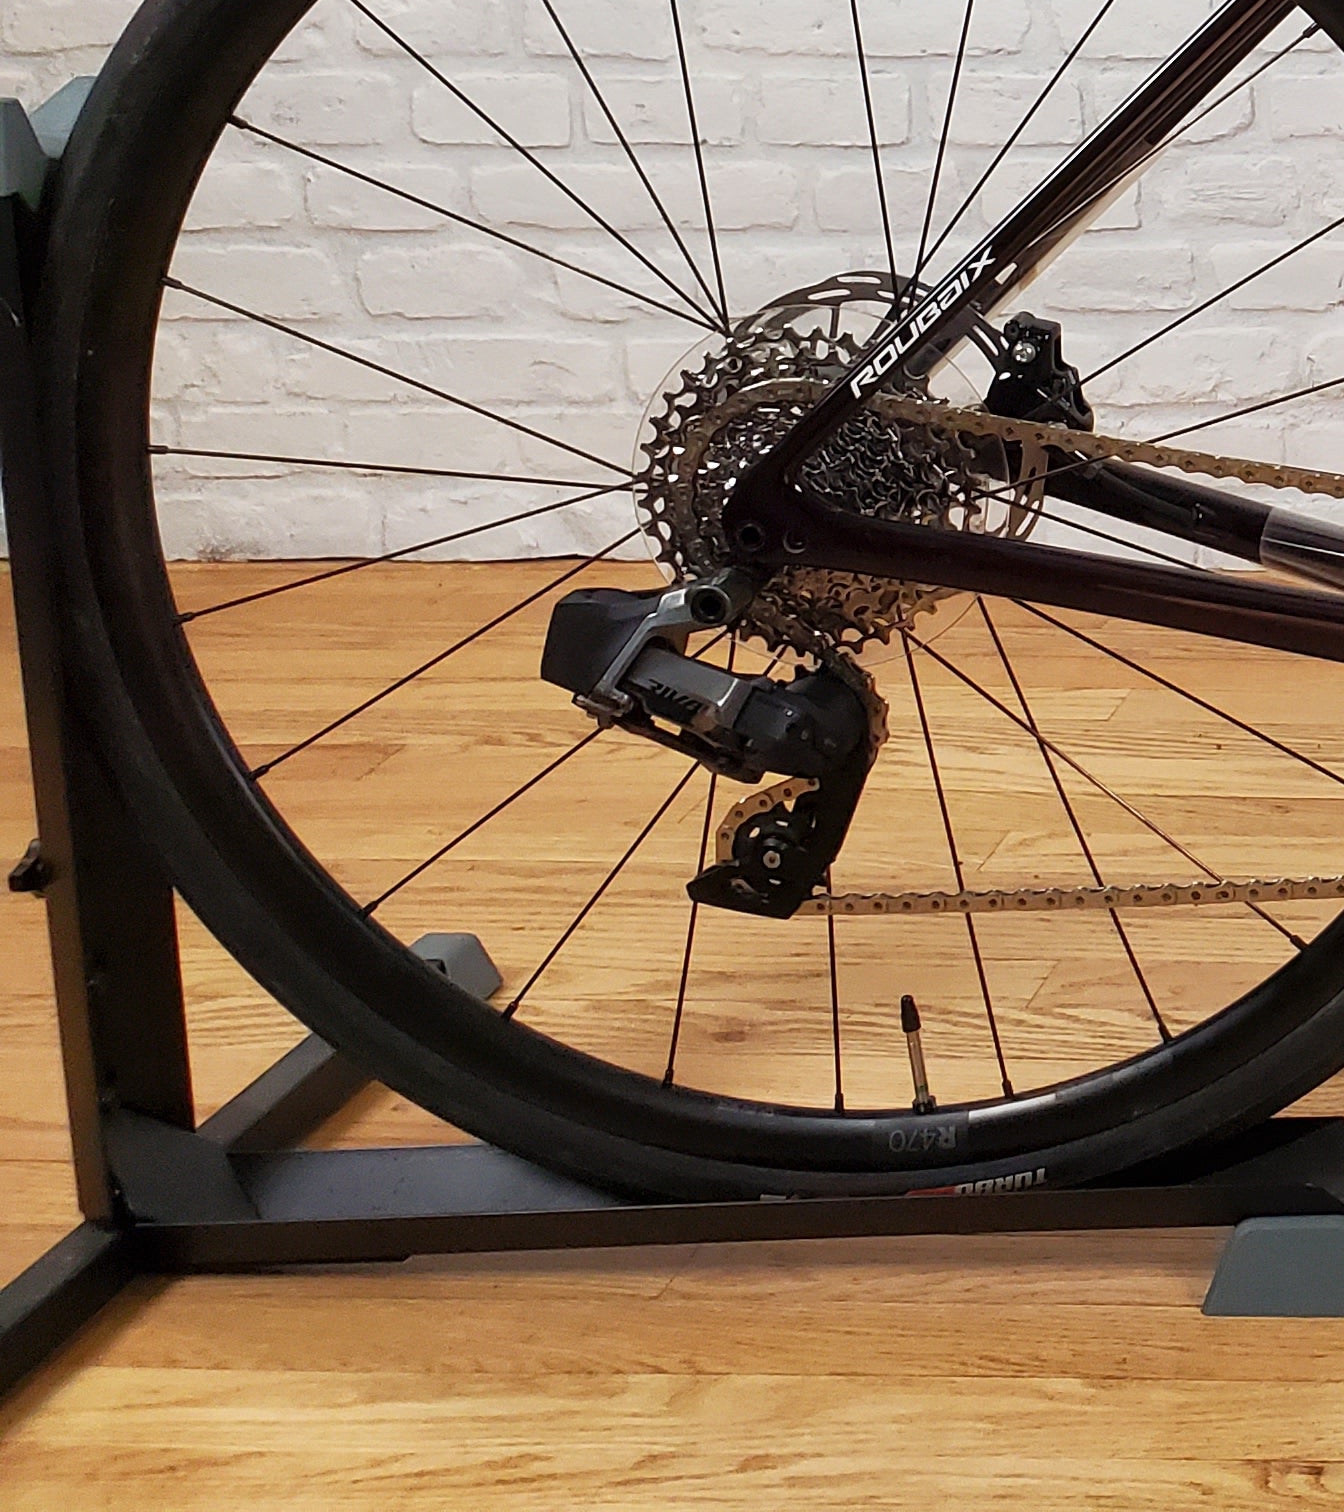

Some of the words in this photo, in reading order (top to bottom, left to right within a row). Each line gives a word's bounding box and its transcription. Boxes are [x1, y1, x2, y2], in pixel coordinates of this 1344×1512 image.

[850, 245, 996, 400] ROUBAIX
[889, 1125, 957, 1153] R470
[954, 1167, 1048, 1196] TURBO
